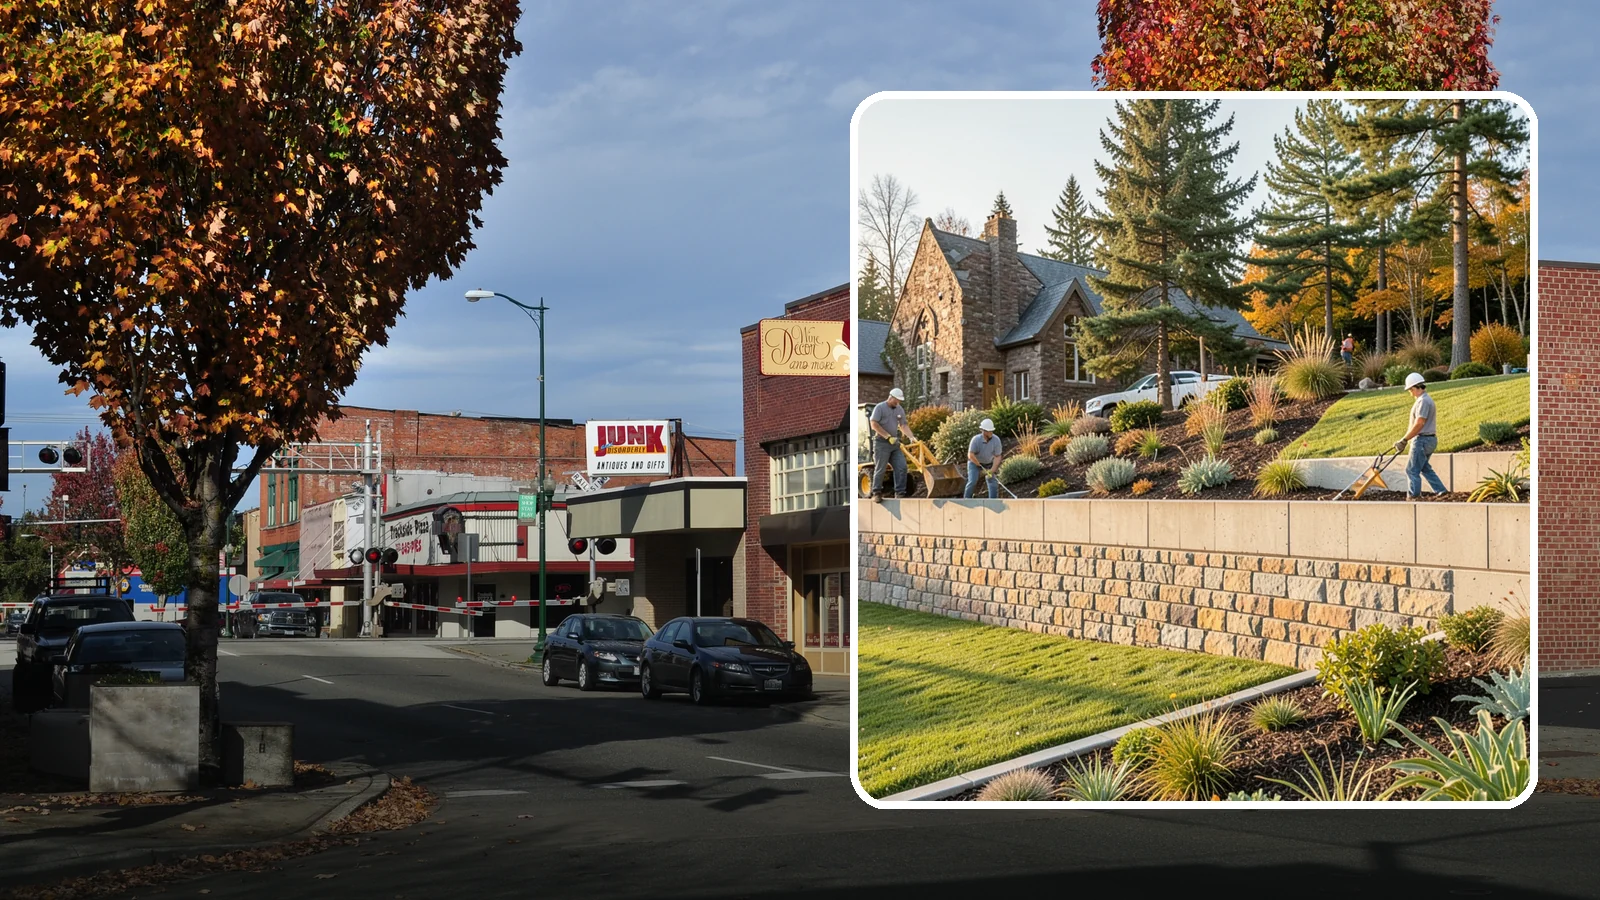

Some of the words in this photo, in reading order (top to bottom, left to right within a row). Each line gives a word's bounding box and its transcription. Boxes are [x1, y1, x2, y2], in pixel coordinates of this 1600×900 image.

[596, 425, 665, 457] JUNK
[608, 446, 645, 454] DISORDERLY
[597, 461, 627, 470] ANTIQUES
[631, 461, 643, 470] AND
[647, 461, 665, 469] GIFTS
[414, 519, 429, 535] Pizza
